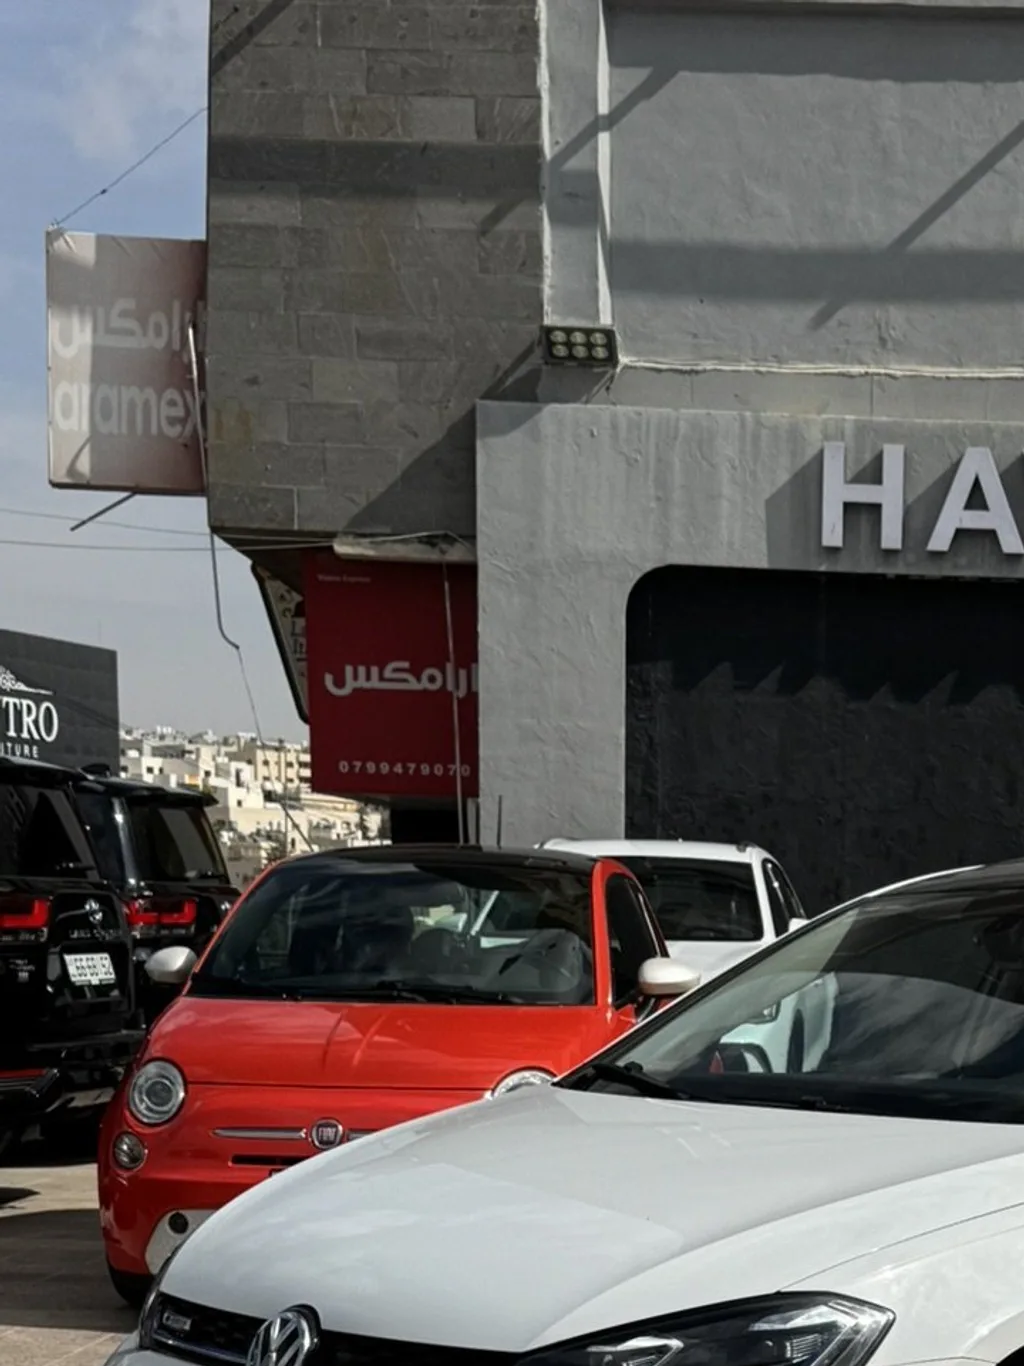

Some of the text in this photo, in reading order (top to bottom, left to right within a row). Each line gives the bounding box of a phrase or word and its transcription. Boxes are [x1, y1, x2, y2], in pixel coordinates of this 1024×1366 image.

[54, 380, 207, 440] aramex
[0, 696, 59, 742] TRO
[338, 760, 471, 777] 0799479070
